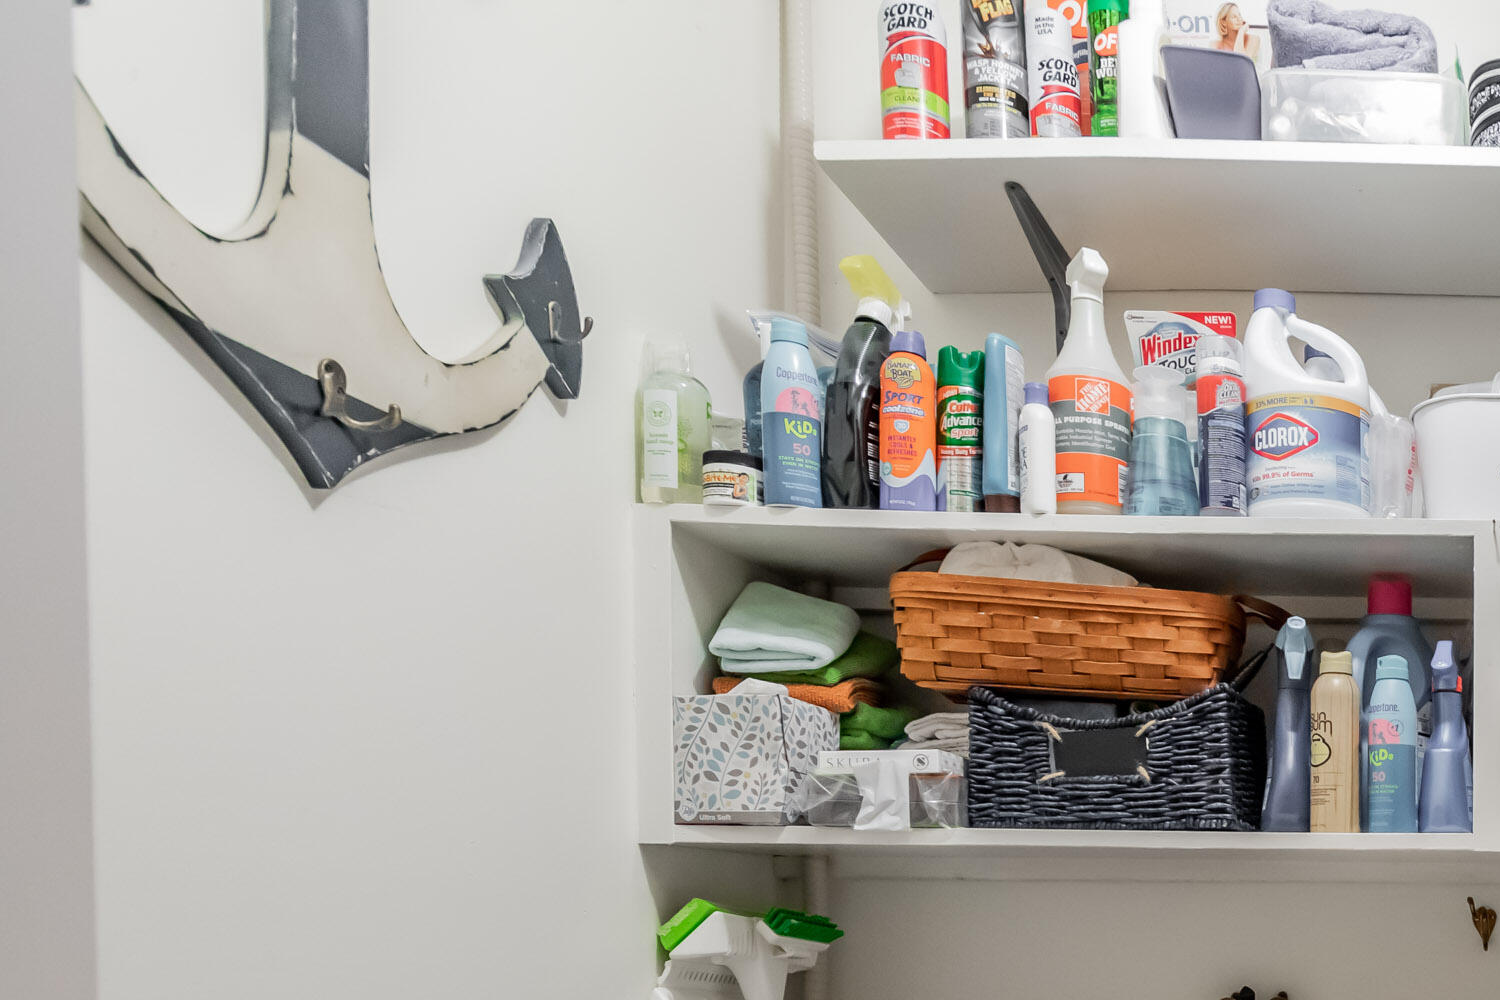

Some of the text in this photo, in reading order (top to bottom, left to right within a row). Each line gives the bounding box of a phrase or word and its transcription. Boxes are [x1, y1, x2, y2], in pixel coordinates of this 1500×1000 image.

[884, 3, 932, 22] SCOTCH
[981, 1, 1015, 22] FLAG
[887, 18, 927, 32] GARD
[890, 53, 930, 67] FABRIC
[1043, 71, 1077, 88] GARD
[1045, 101, 1079, 122] FABRIC
[1204, 315, 1232, 324] NEW!
[1141, 332, 1201, 366] Windex
[892, 370, 912, 379] BOAT
[884, 390, 924, 404] SPORT
[1076, 382, 1109, 412] HOME
[1267, 396, 1288, 405] MORE
[942, 415, 982, 429] Advance
[1064, 416, 1102, 426] PURPOSE
[951, 428, 978, 439] sport
[1255, 426, 1308, 451] CLOROX
[793, 443, 810, 455] 50
[1372, 771, 1386, 782] 50
